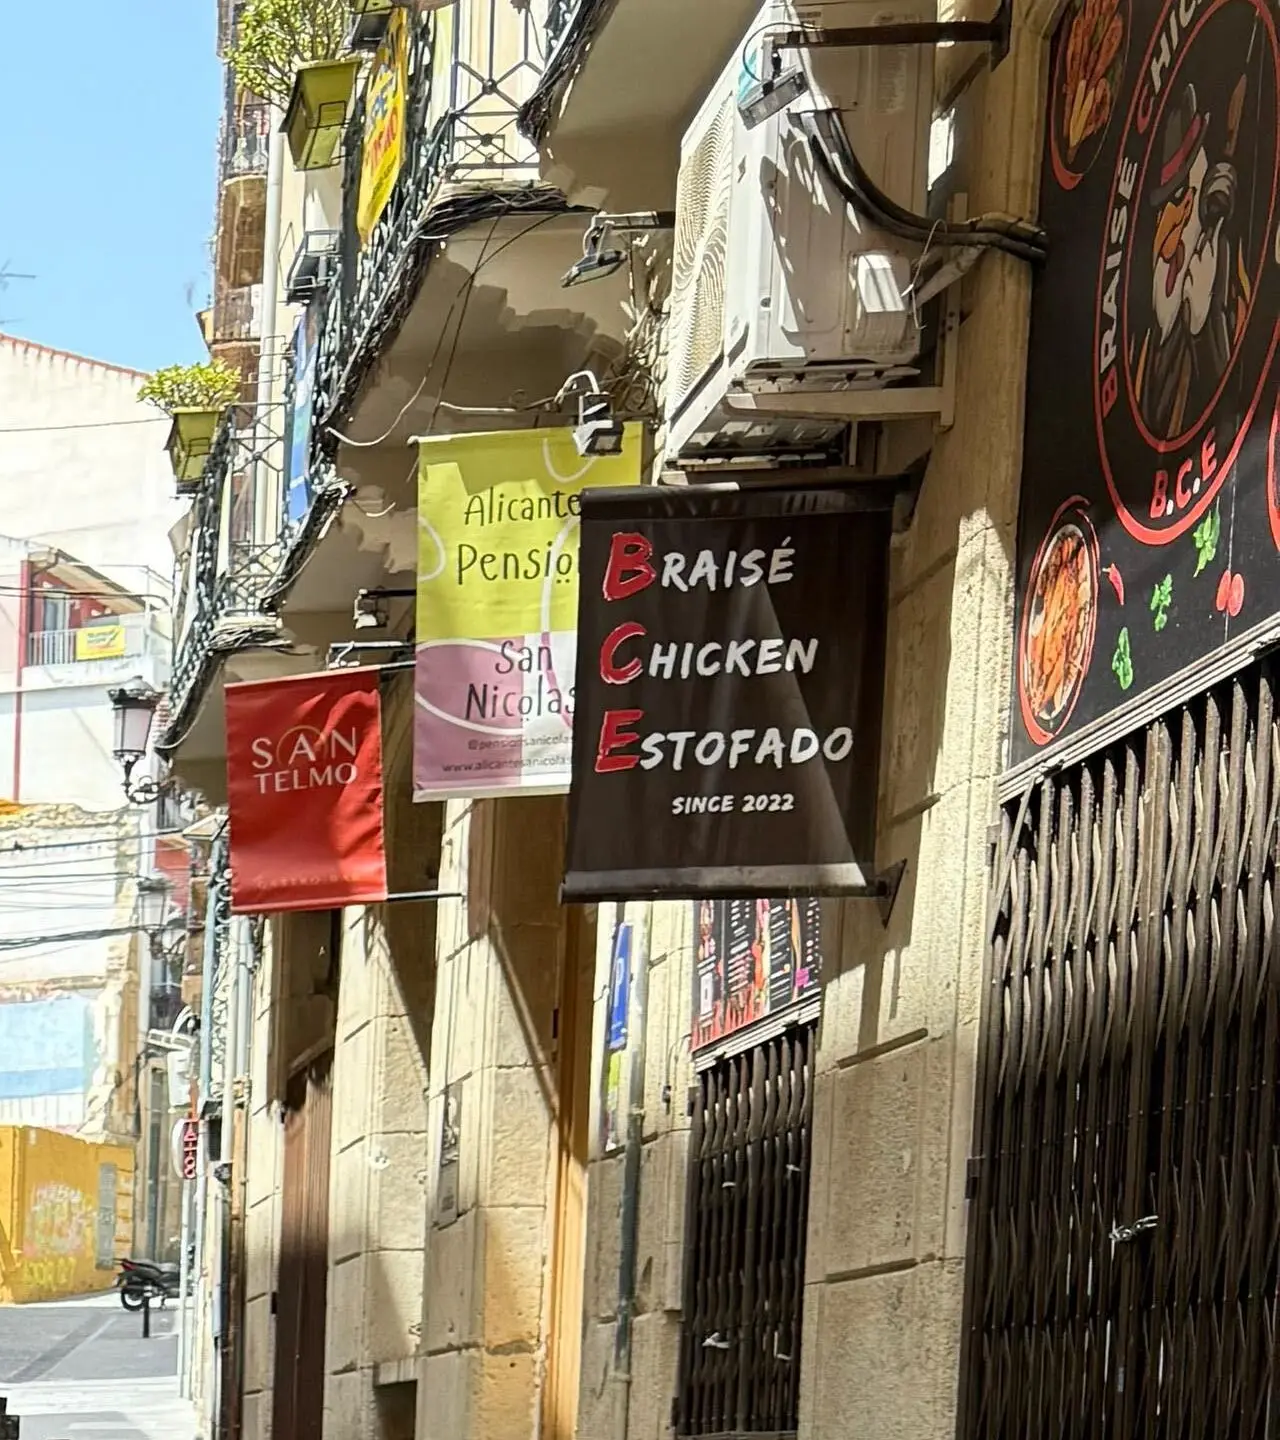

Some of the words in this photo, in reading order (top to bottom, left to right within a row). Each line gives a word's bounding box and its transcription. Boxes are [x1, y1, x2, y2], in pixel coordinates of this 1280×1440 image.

[1137, 0, 1203, 134] CHIC
[464, 486, 583, 526] Alicante
[458, 541, 573, 585] Pensio
[603, 532, 795, 601] BRAISÉ
[495, 640, 552, 674] San
[600, 621, 818, 685] CHICKEN
[251, 727, 357, 769] SAN
[595, 709, 853, 773] ESTOFADO
[254, 762, 358, 794] TELMO
[672, 795, 734, 815] SINCE
[742, 793, 795, 813] 2022
